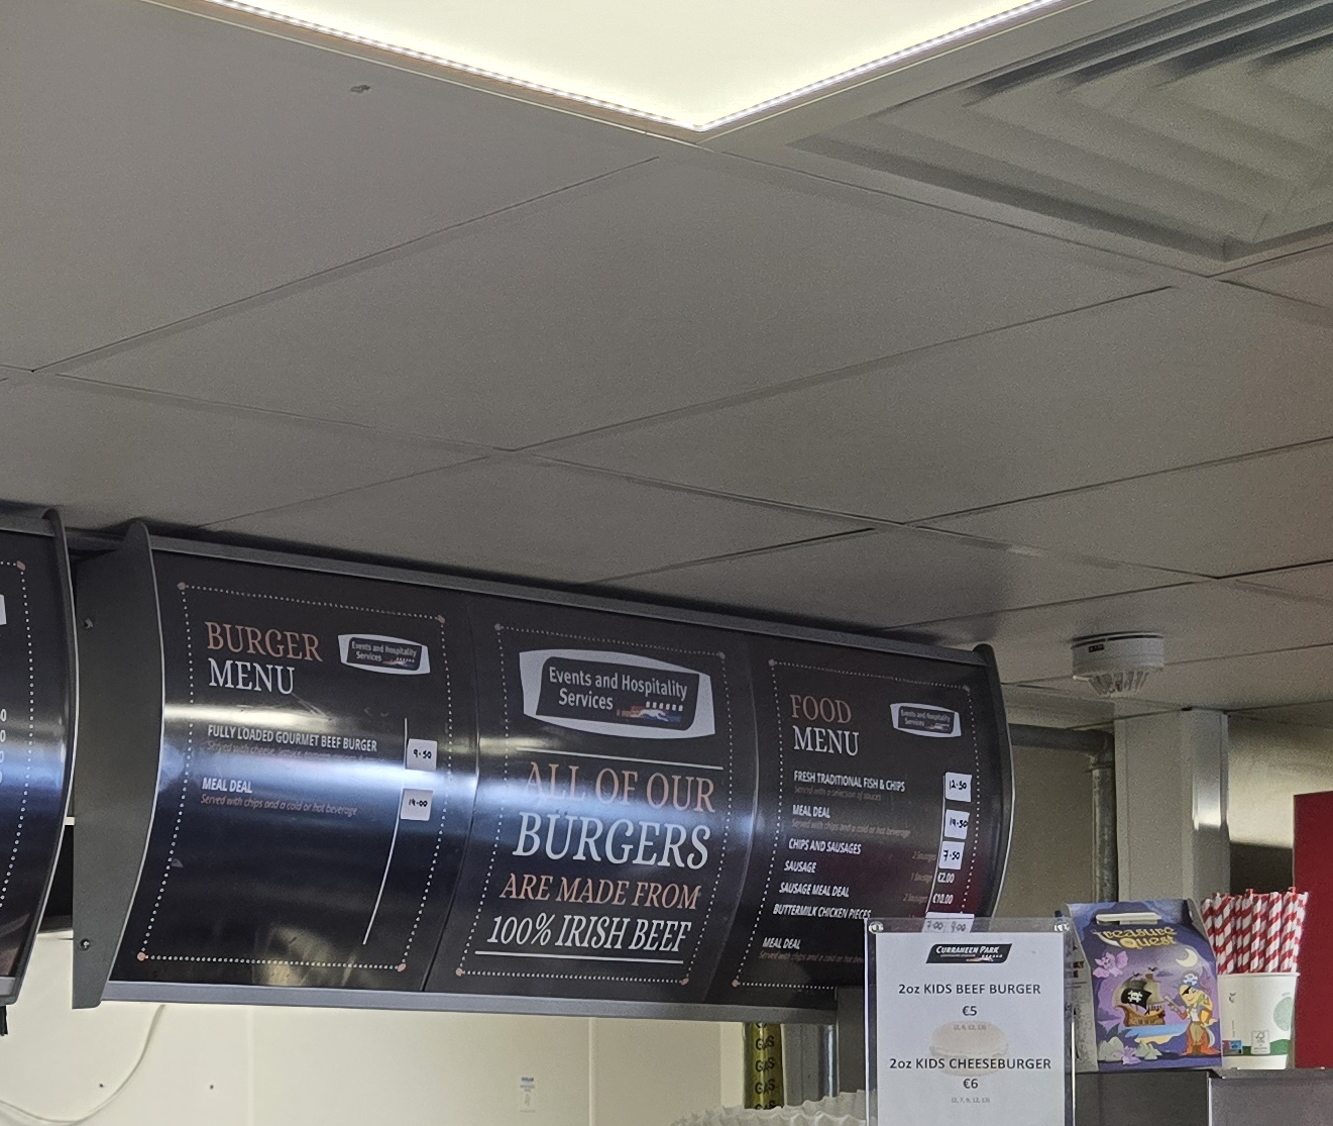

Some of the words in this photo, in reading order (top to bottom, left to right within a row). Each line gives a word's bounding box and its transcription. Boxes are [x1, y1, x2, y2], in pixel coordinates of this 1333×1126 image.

[205, 621, 323, 662] BURGER
[208, 658, 295, 695] MENU
[790, 694, 852, 723] FOOD
[207, 724, 235, 739] FULLY
[237, 727, 274, 742] LOADED
[275, 730, 320, 746] GOURMET
[321, 734, 341, 748] BEEF
[343, 736, 377, 751] BURGER
[792, 725, 860, 756] MENU
[524, 762, 585, 798] ALL
[595, 767, 639, 805] OF
[646, 772, 715, 813] OUR
[512, 812, 711, 870] BURGERS
[499, 873, 553, 900] ARE
[556, 876, 629, 906] MADE
[631, 882, 701, 909] FROM
[487, 912, 555, 945] 100%
[555, 915, 630, 949] IRISH
[629, 920, 691, 951] BEEF
[1093, 926, 1177, 942] Treasure
[1119, 936, 1178, 949] Quest
[936, 946, 978, 954] CURRAHEEN
[980, 946, 999, 954] PARK
[898, 983, 920, 994] 2oz
[924, 984, 952, 994] KIDS
[956, 984, 985, 994] BEEF
[989, 984, 1041, 994] BURGER
[962, 1005, 977, 1016] €5
[755, 1035, 775, 1050] GAS
